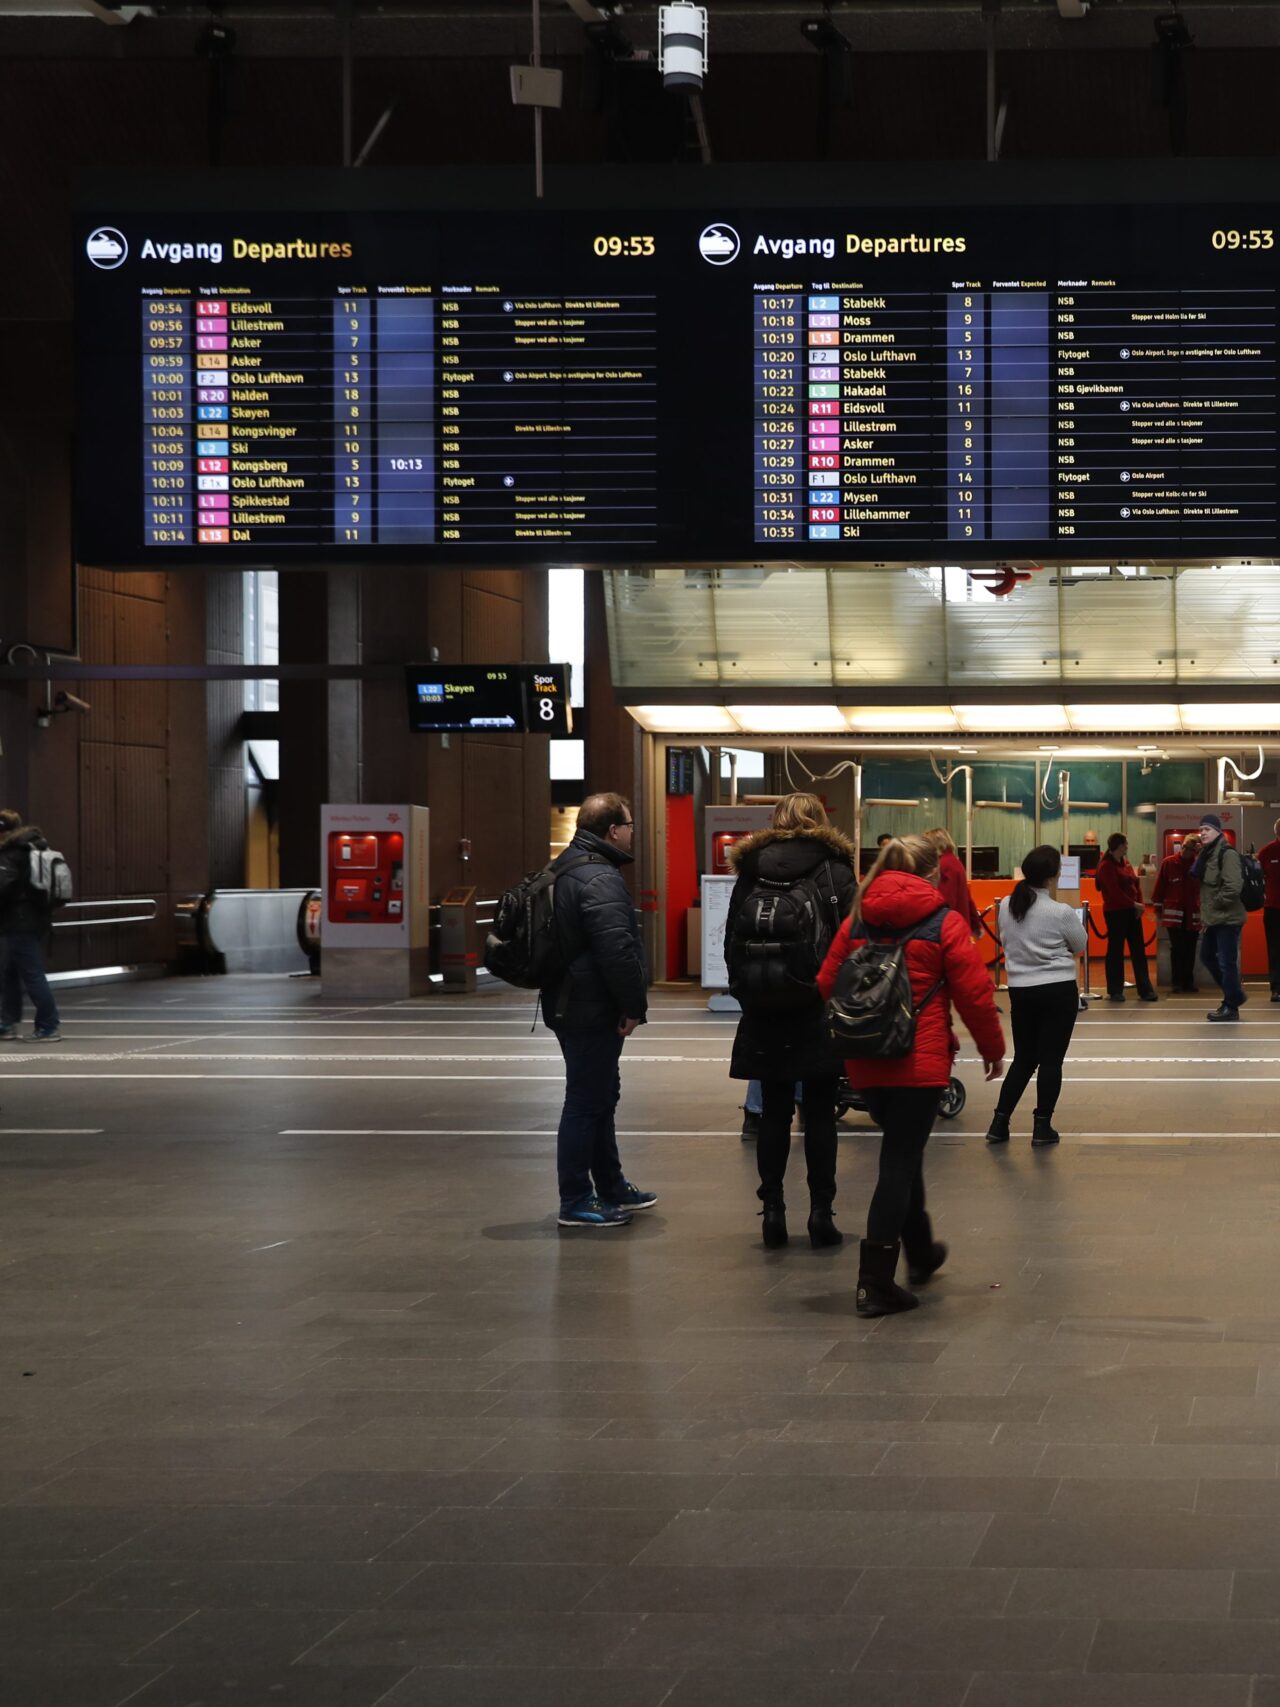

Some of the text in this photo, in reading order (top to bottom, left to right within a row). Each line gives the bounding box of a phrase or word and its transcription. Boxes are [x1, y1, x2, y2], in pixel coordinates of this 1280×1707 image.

[1212, 230, 1273, 249] 09:53
[141, 238, 352, 263] Avgang Departures
[594, 237, 655, 255] 09:53
[754, 234, 966, 258] Avgang Departures
[231, 303, 272, 313] Eidsvoll
[763, 298, 885, 309] 10:17 Stabekk
[232, 320, 284, 330] Lillestrøm
[763, 316, 871, 326] 10:18 Moss
[231, 338, 261, 347] Asker
[763, 333, 894, 343] 10:19 Drammen
[231, 356, 261, 366] Asker
[763, 351, 1089, 362] 10:20 Oslo Lufthavn Flytoget
[231, 372, 303, 383] Oslo Lufthavn
[763, 368, 886, 379] 10:21 Stabekk
[232, 390, 268, 400] Halden
[763, 386, 793, 396] 10:22
[844, 385, 886, 396] Hakadal
[1077, 385, 1123, 393] Gjøvikbanen
[232, 407, 269, 419] Skøyen
[763, 403, 885, 414] 10:24 Eidsvoll
[232, 426, 296, 438] Kongsvinger
[763, 421, 896, 432] 10:26 Lillestrøm
[232, 443, 248, 453] Ski
[763, 439, 873, 449] 10:27 Asker
[232, 459, 422, 473] Kongsberg 10:13
[763, 456, 894, 467] 10:29 Drammen
[232, 477, 304, 488] Oslo Lufthavn
[763, 473, 916, 484] 10:30 Oslo Lufthavn
[232, 496, 289, 506] Spikkestad
[763, 492, 878, 504] 10:31 Mysen
[233, 513, 285, 523] Lillestrøm
[763, 509, 910, 520] 10:34 Lillehammer
[233, 530, 250, 540] Dal
[763, 526, 859, 537] 10:35 Ski
[534, 675, 554, 684] Spor
[444, 684, 474, 694] Skøyen
[535, 684, 557, 692] Track
[540, 698, 554, 720] 8
